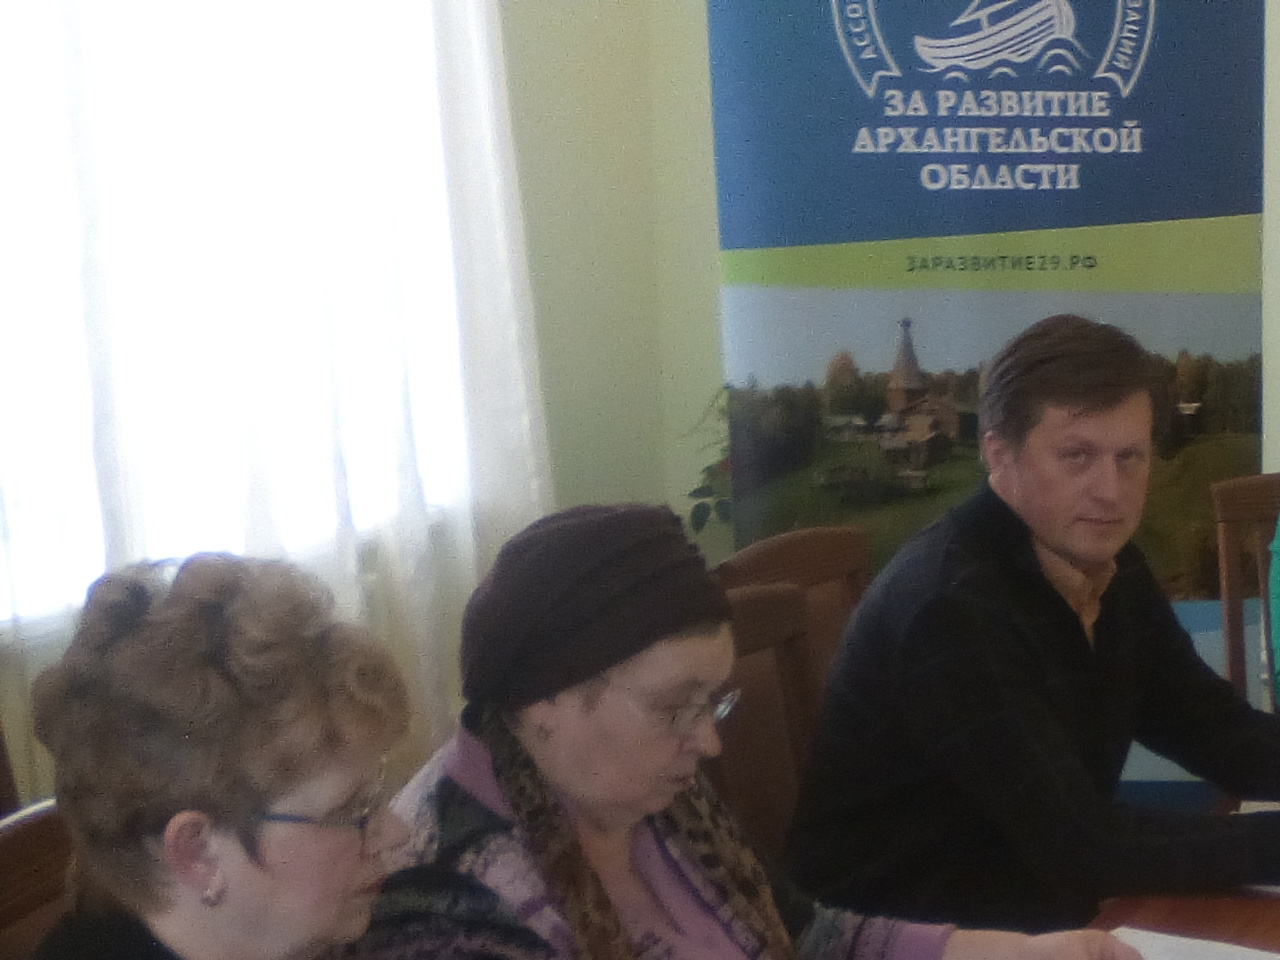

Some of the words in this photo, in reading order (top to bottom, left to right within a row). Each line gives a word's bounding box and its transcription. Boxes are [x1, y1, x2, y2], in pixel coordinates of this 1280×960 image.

[845, 0, 878, 59] АССО
[883, 89, 929, 117] ЗА
[935, 89, 1111, 117] РАЗВИТИЕ
[851, 120, 1143, 154] АРХАНГЕЛЬСКОЙ
[920, 163, 1081, 190] ОБЛАСТИ
[907, 255, 1097, 272] ЗАРАЗВИТИЕ29.РФ
